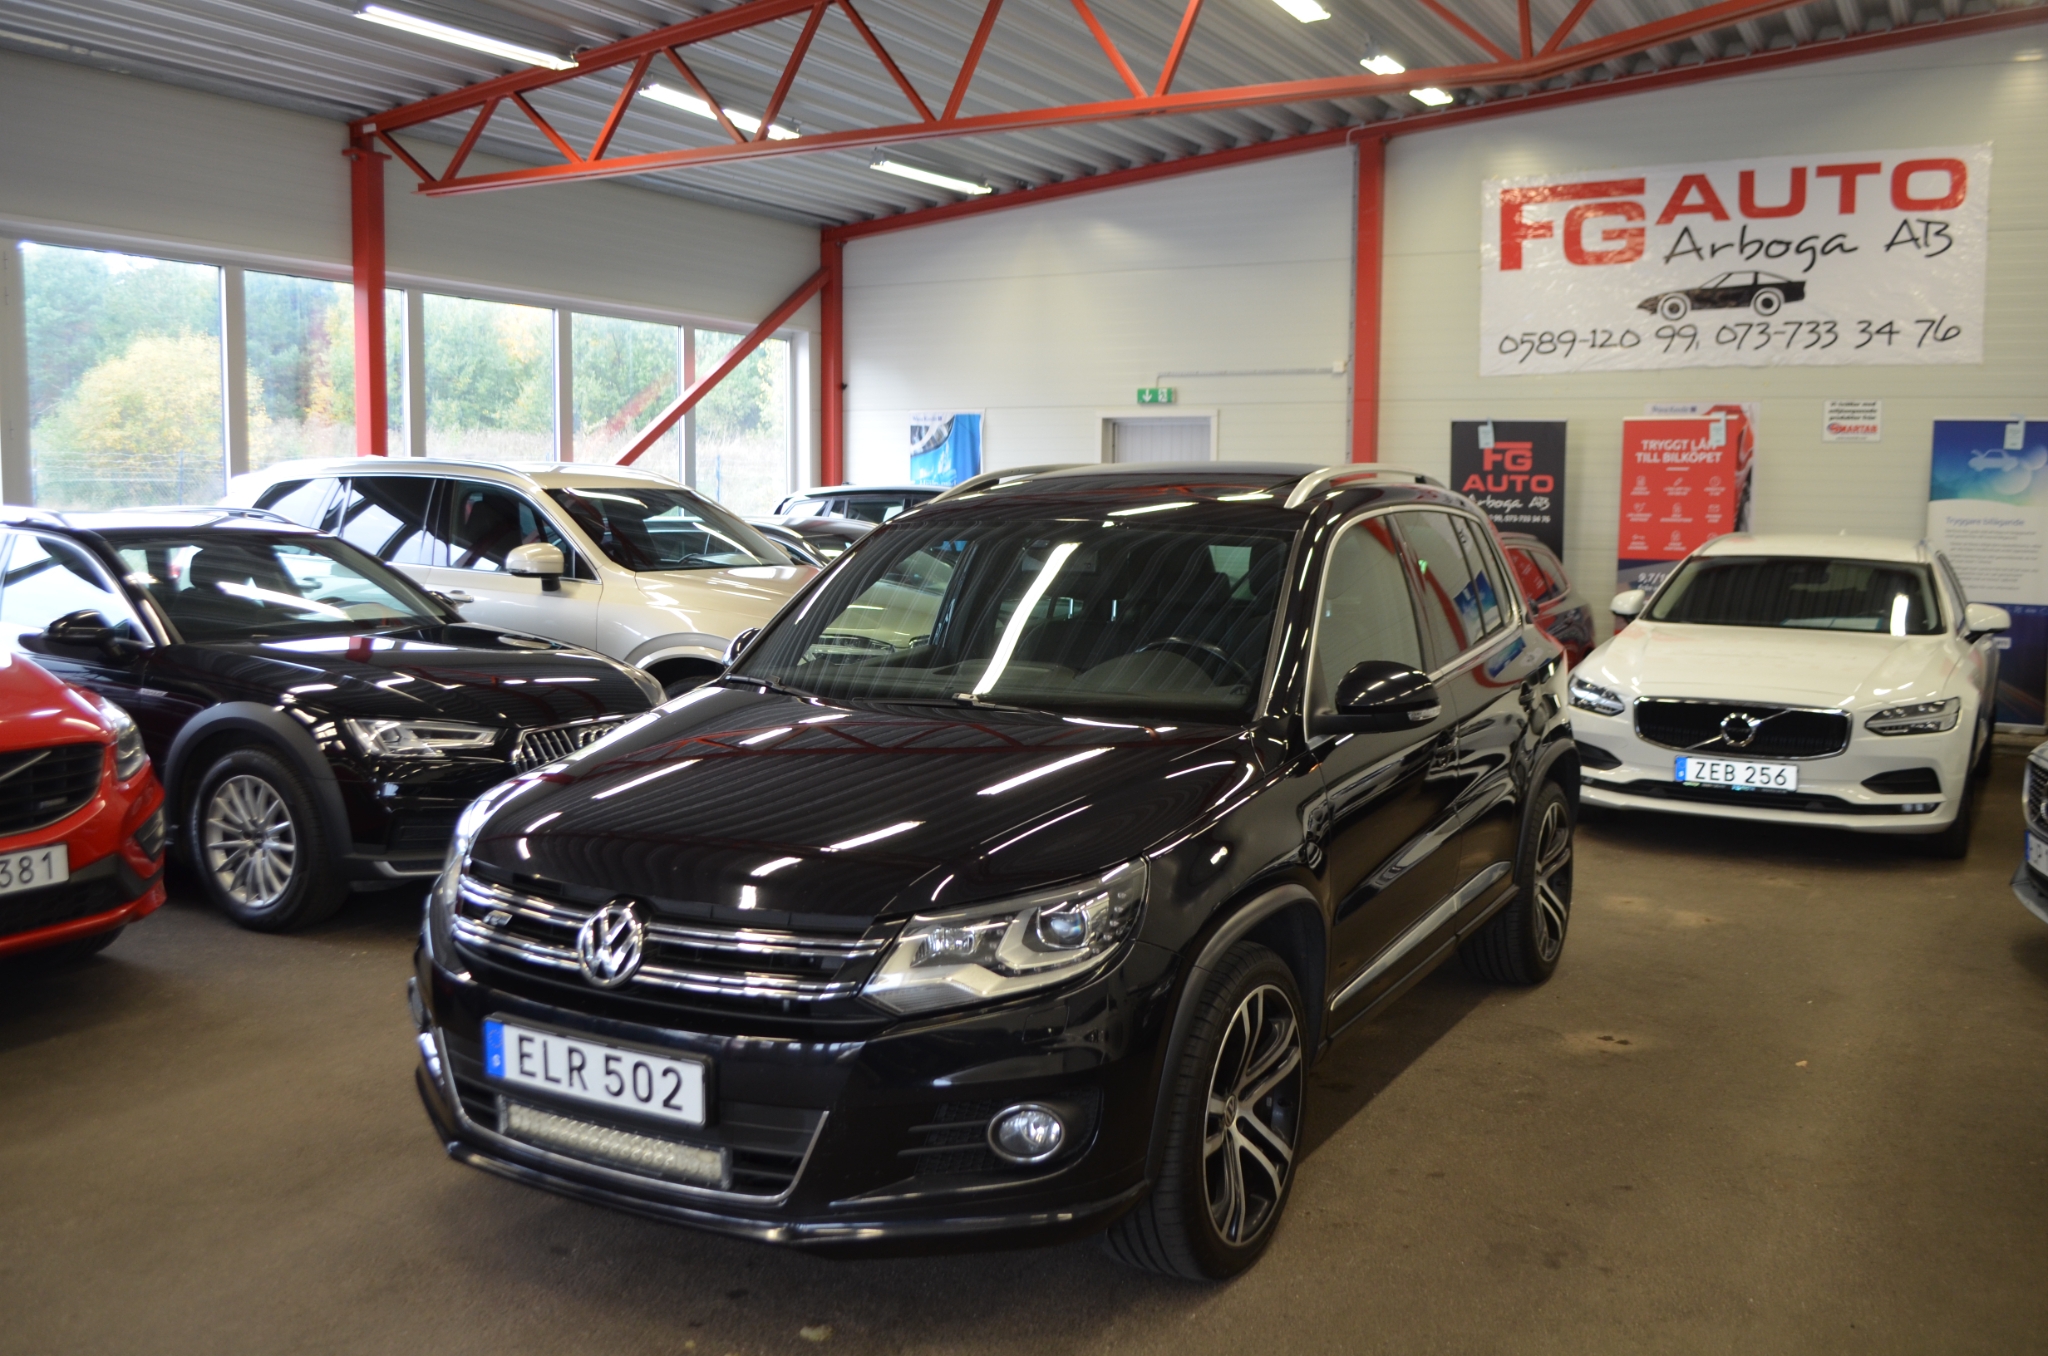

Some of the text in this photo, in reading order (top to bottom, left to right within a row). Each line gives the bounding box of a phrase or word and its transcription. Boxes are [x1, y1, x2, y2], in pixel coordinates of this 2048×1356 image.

[1499, 158, 1969, 271] FG AUTO
[1664, 219, 1954, 274] Arboga AB
[1499, 328, 1642, 364] 0589-120
[1715, 320, 1839, 351] 073-733
[1855, 320, 1900, 348] 34
[1915, 315, 1961, 348] 76
[1482, 441, 1533, 472] FG
[1635, 450, 1723, 463] TILL BILKÖPET
[1641, 439, 1689, 450] TRYGGT
[1461, 473, 1555, 493] AUTO
[1528, 495, 1550, 511] AB
[1695, 761, 1787, 786] ZEB 256
[518, 1034, 683, 1112] ELR 502
